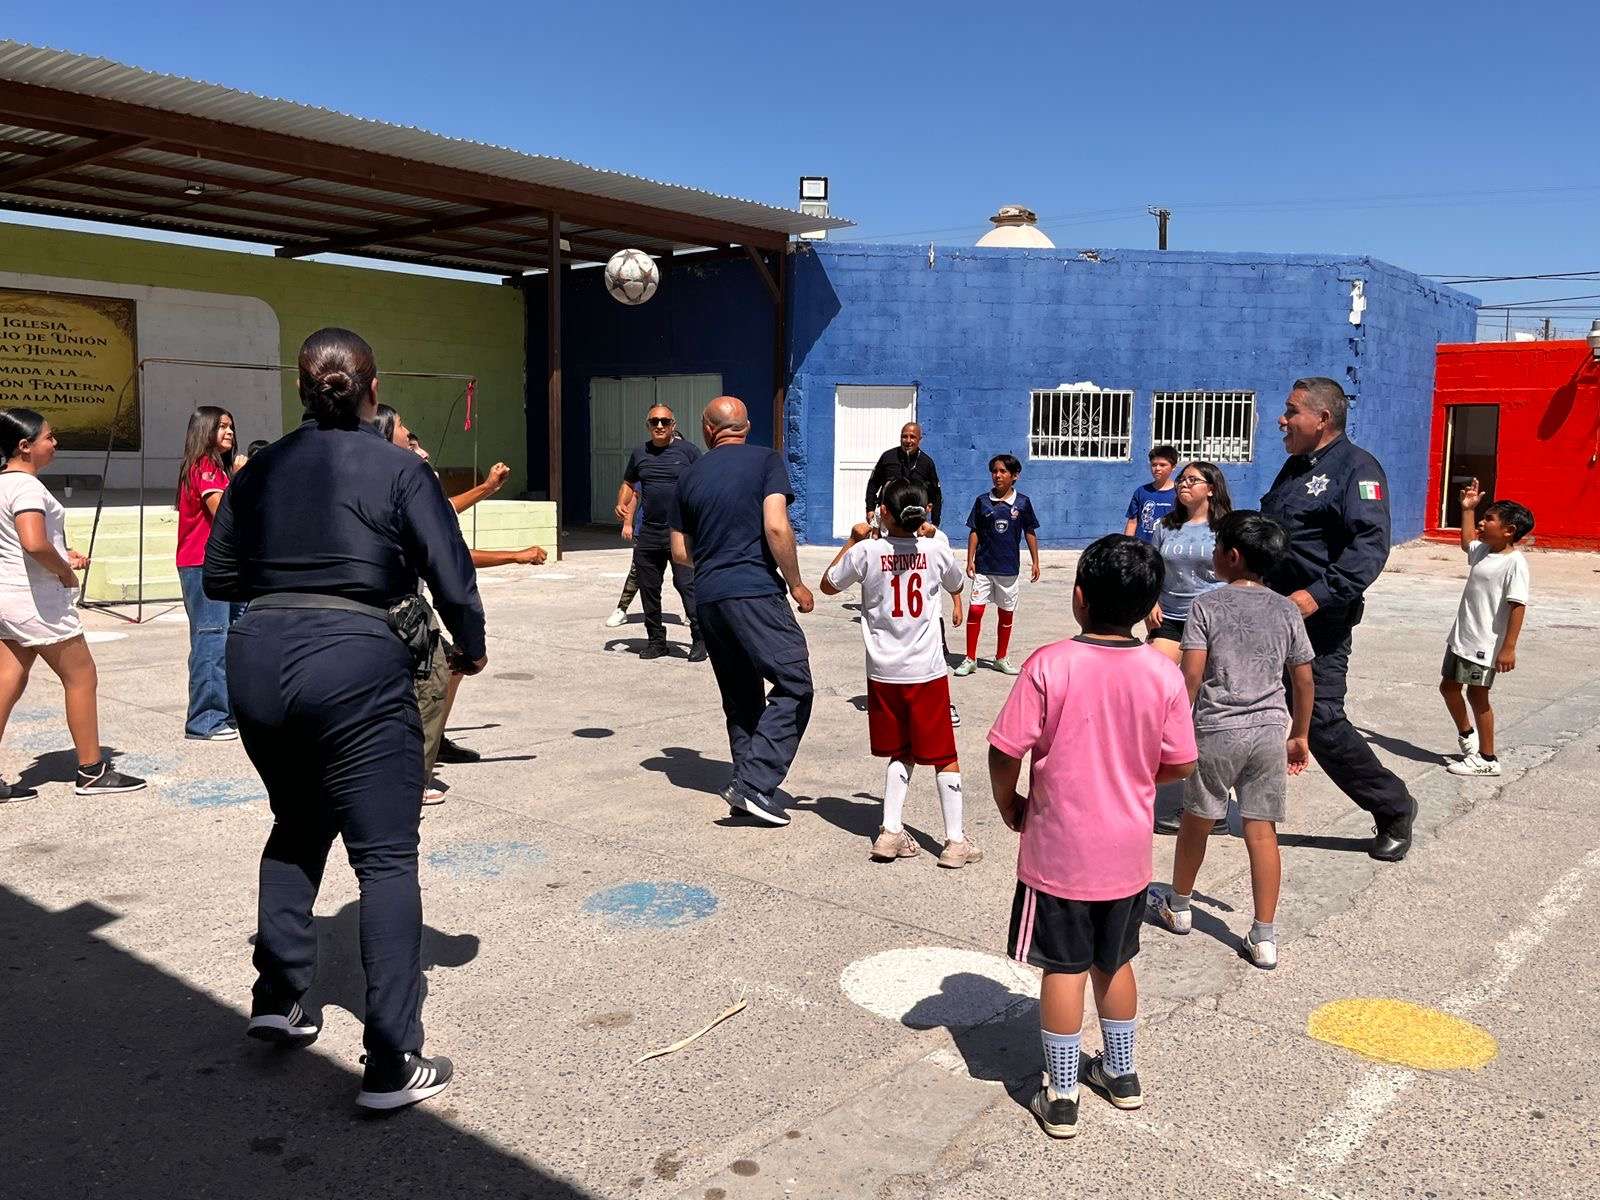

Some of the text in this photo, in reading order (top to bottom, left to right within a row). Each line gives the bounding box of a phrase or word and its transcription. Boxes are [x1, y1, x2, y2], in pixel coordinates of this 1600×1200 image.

[0, 331, 107, 346] IO DE UNIÓN
[60, 369, 77, 377] LA
[29, 379, 115, 392] FRATERNA
[35, 394, 50, 402] LA
[880, 553, 927, 572] ESPINOZA
[890, 572, 923, 618] 16
